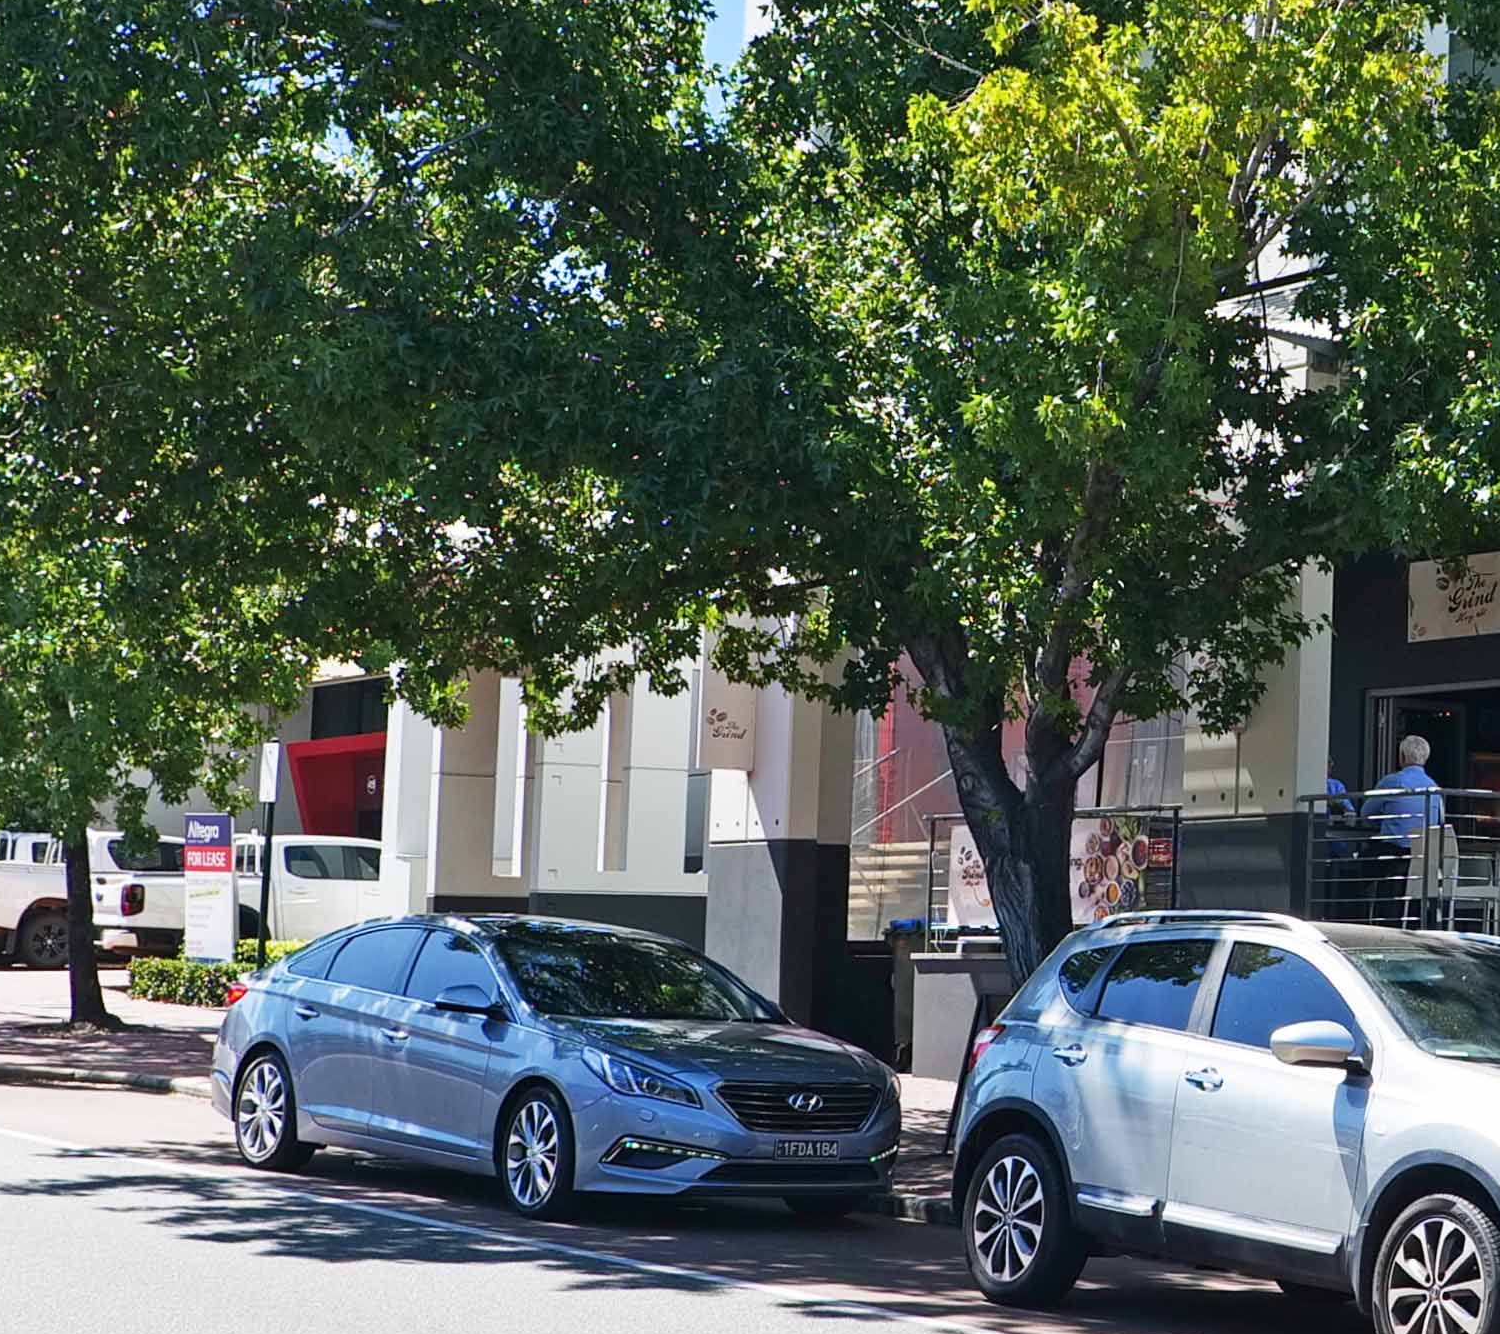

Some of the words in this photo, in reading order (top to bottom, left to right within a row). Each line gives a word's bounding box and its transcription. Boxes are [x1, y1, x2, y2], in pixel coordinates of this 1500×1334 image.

[1448, 580, 1498, 613] Grind
[187, 851, 201, 867] FOR
[202, 850, 227, 867] LEASE
